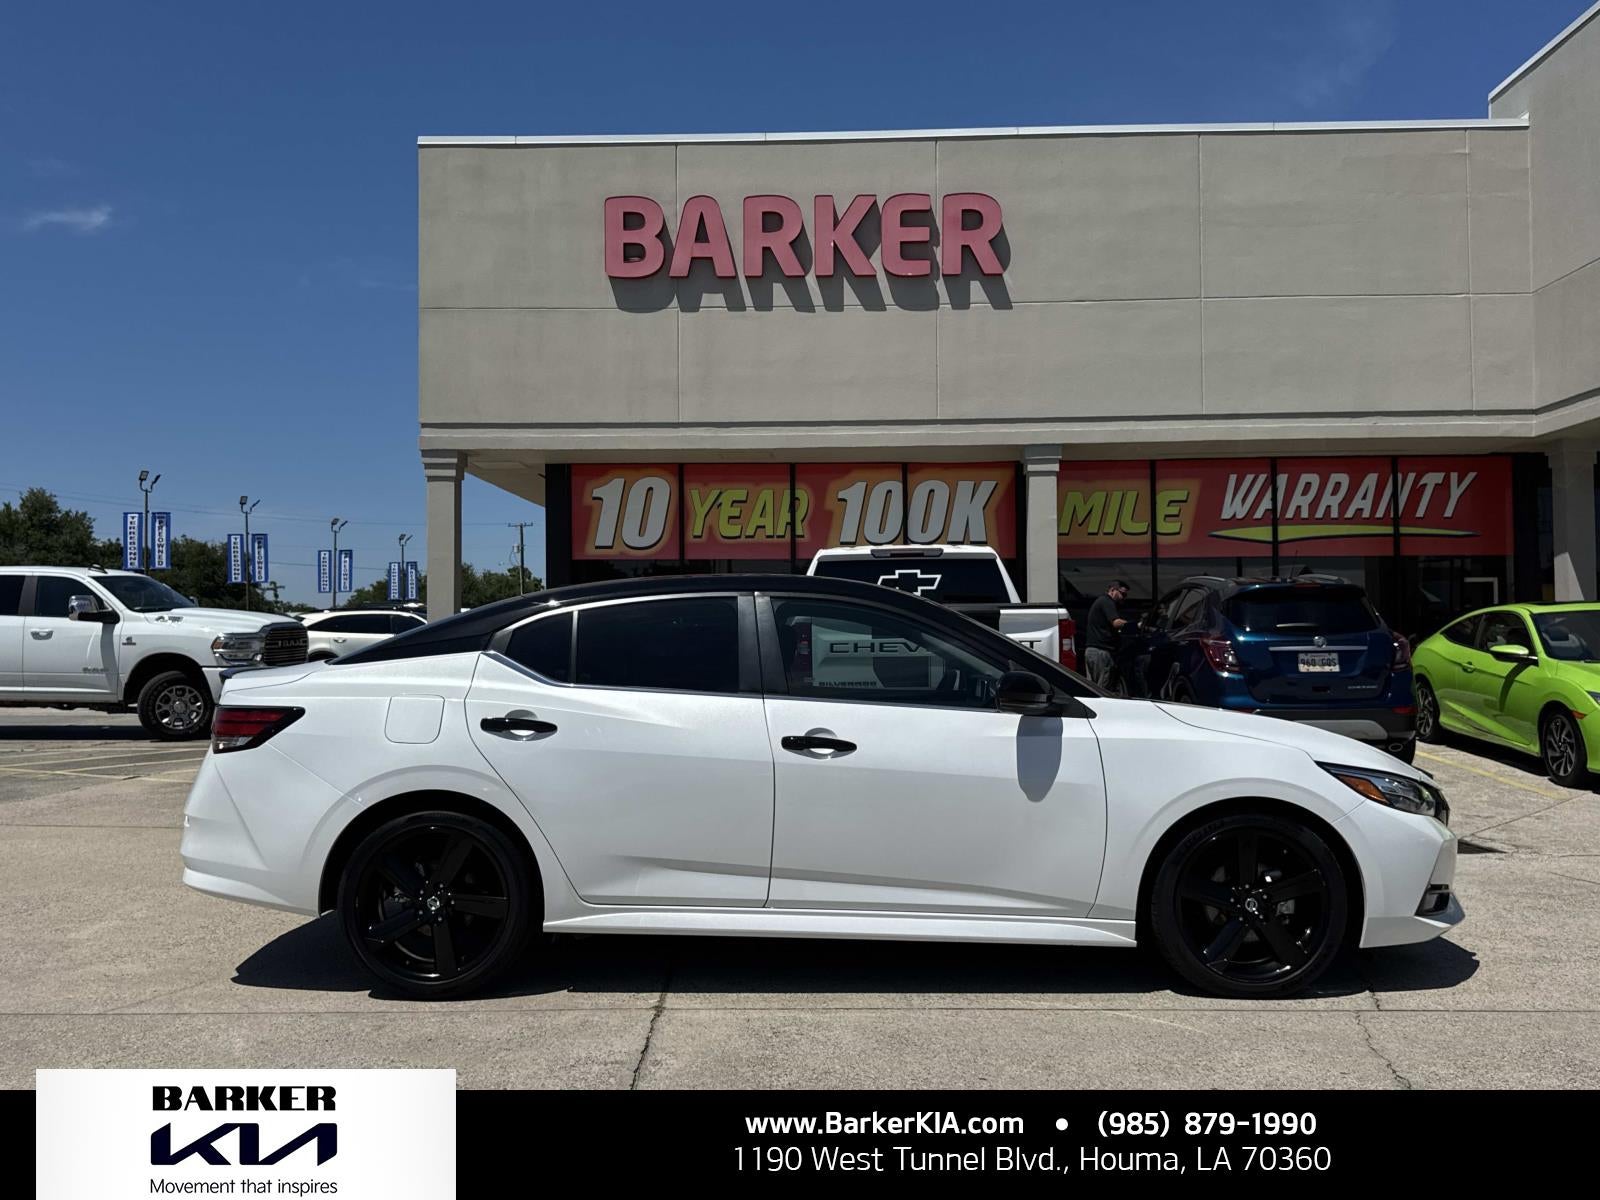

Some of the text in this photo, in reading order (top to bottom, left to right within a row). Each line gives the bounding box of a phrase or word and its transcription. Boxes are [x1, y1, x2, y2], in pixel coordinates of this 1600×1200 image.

[604, 193, 1005, 278] BARKER
[591, 472, 1478, 550] 10 YEAR 100K MILE WARRANTY
